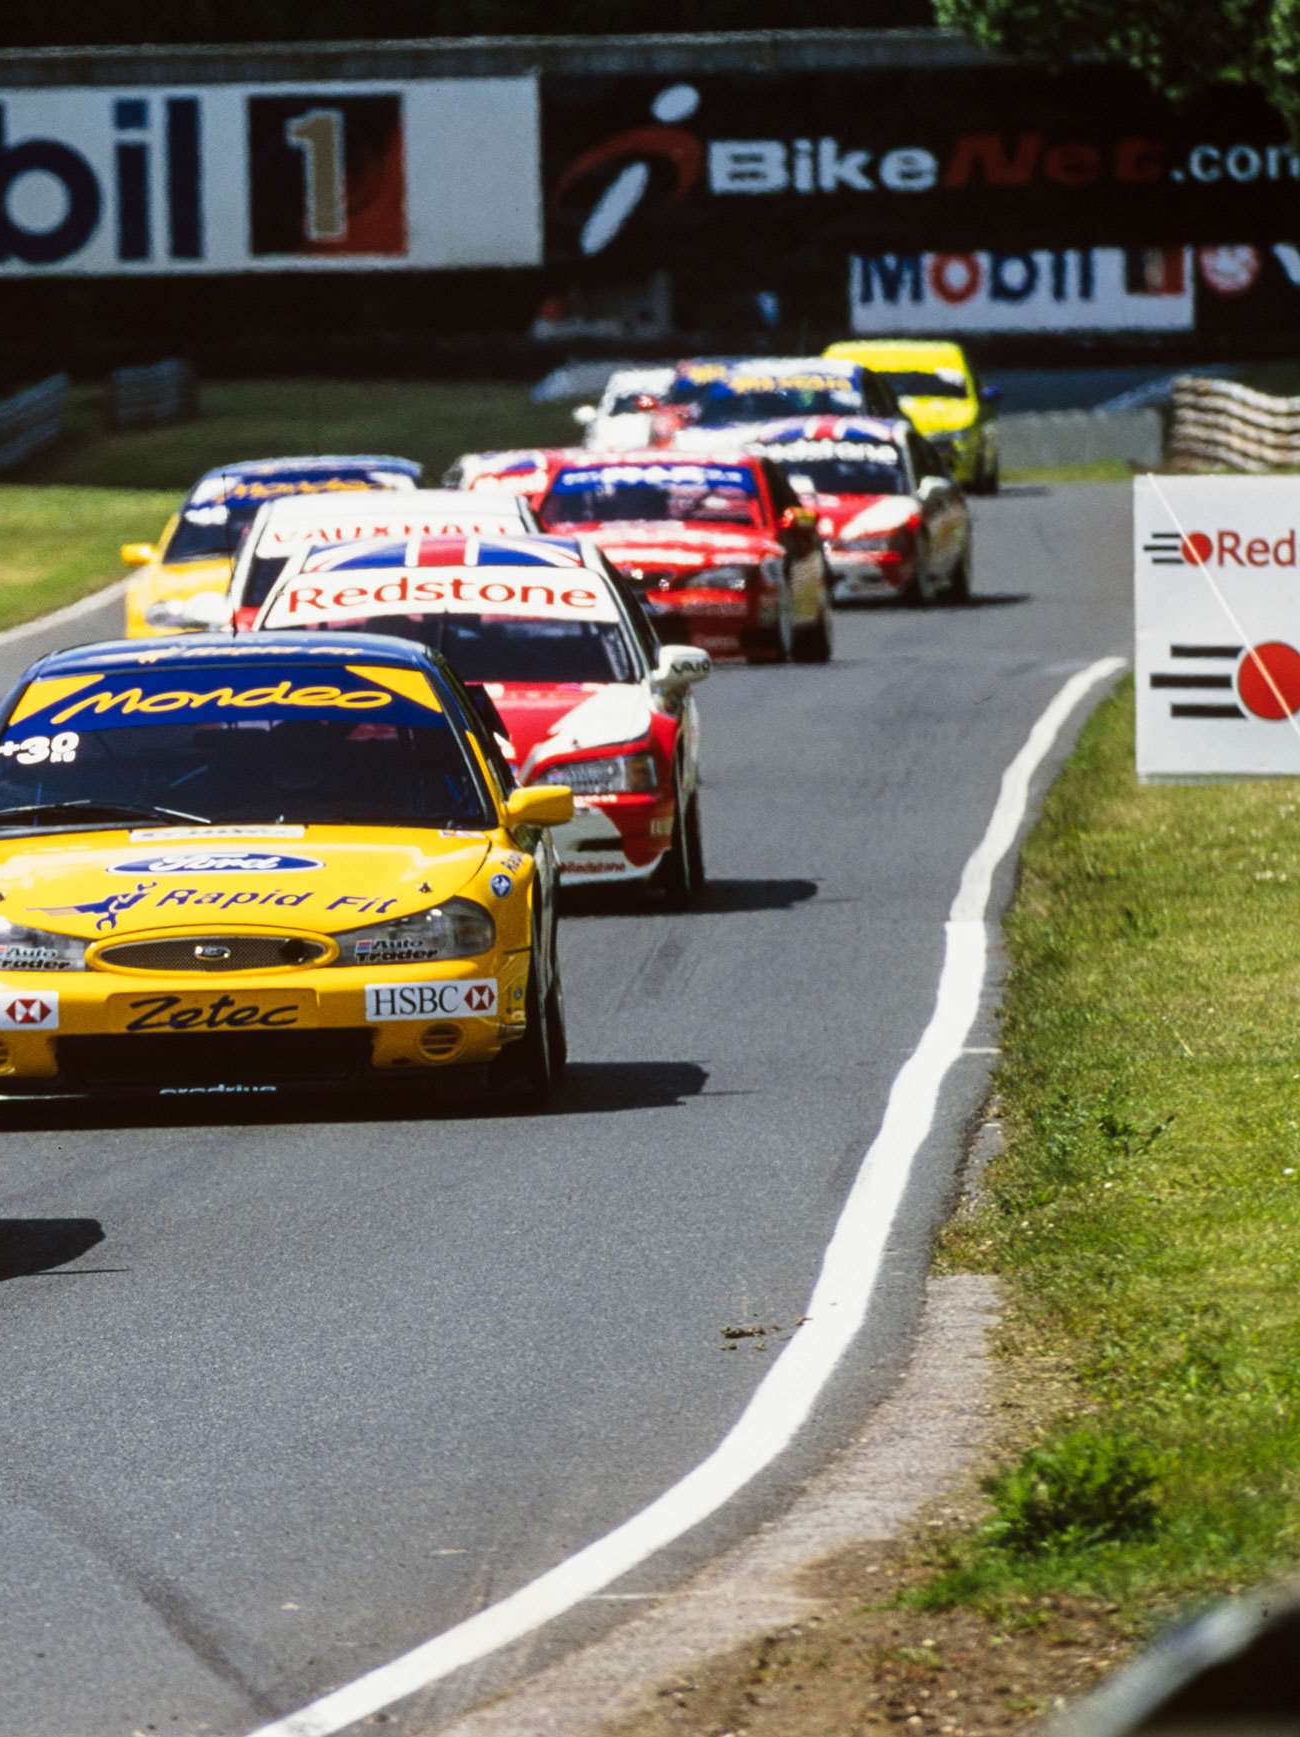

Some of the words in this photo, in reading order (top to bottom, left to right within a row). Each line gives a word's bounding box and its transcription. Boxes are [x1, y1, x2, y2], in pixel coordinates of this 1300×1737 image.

[286, 108, 346, 243] 1
[273, 523, 507, 544] VAUXHA
[1217, 528, 1297, 568] Red
[287, 576, 597, 613] Redstone
[50, 680, 393, 725] Mondeo
[148, 851, 283, 873] Ford
[156, 888, 315, 910] Rapid
[325, 896, 399, 914] Fit
[4, 944, 58, 959] Auto
[355, 949, 439, 963] Trader
[371, 938, 424, 951] Auto
[125, 993, 300, 1032] Zetec
[373, 984, 460, 1017] HSBC
